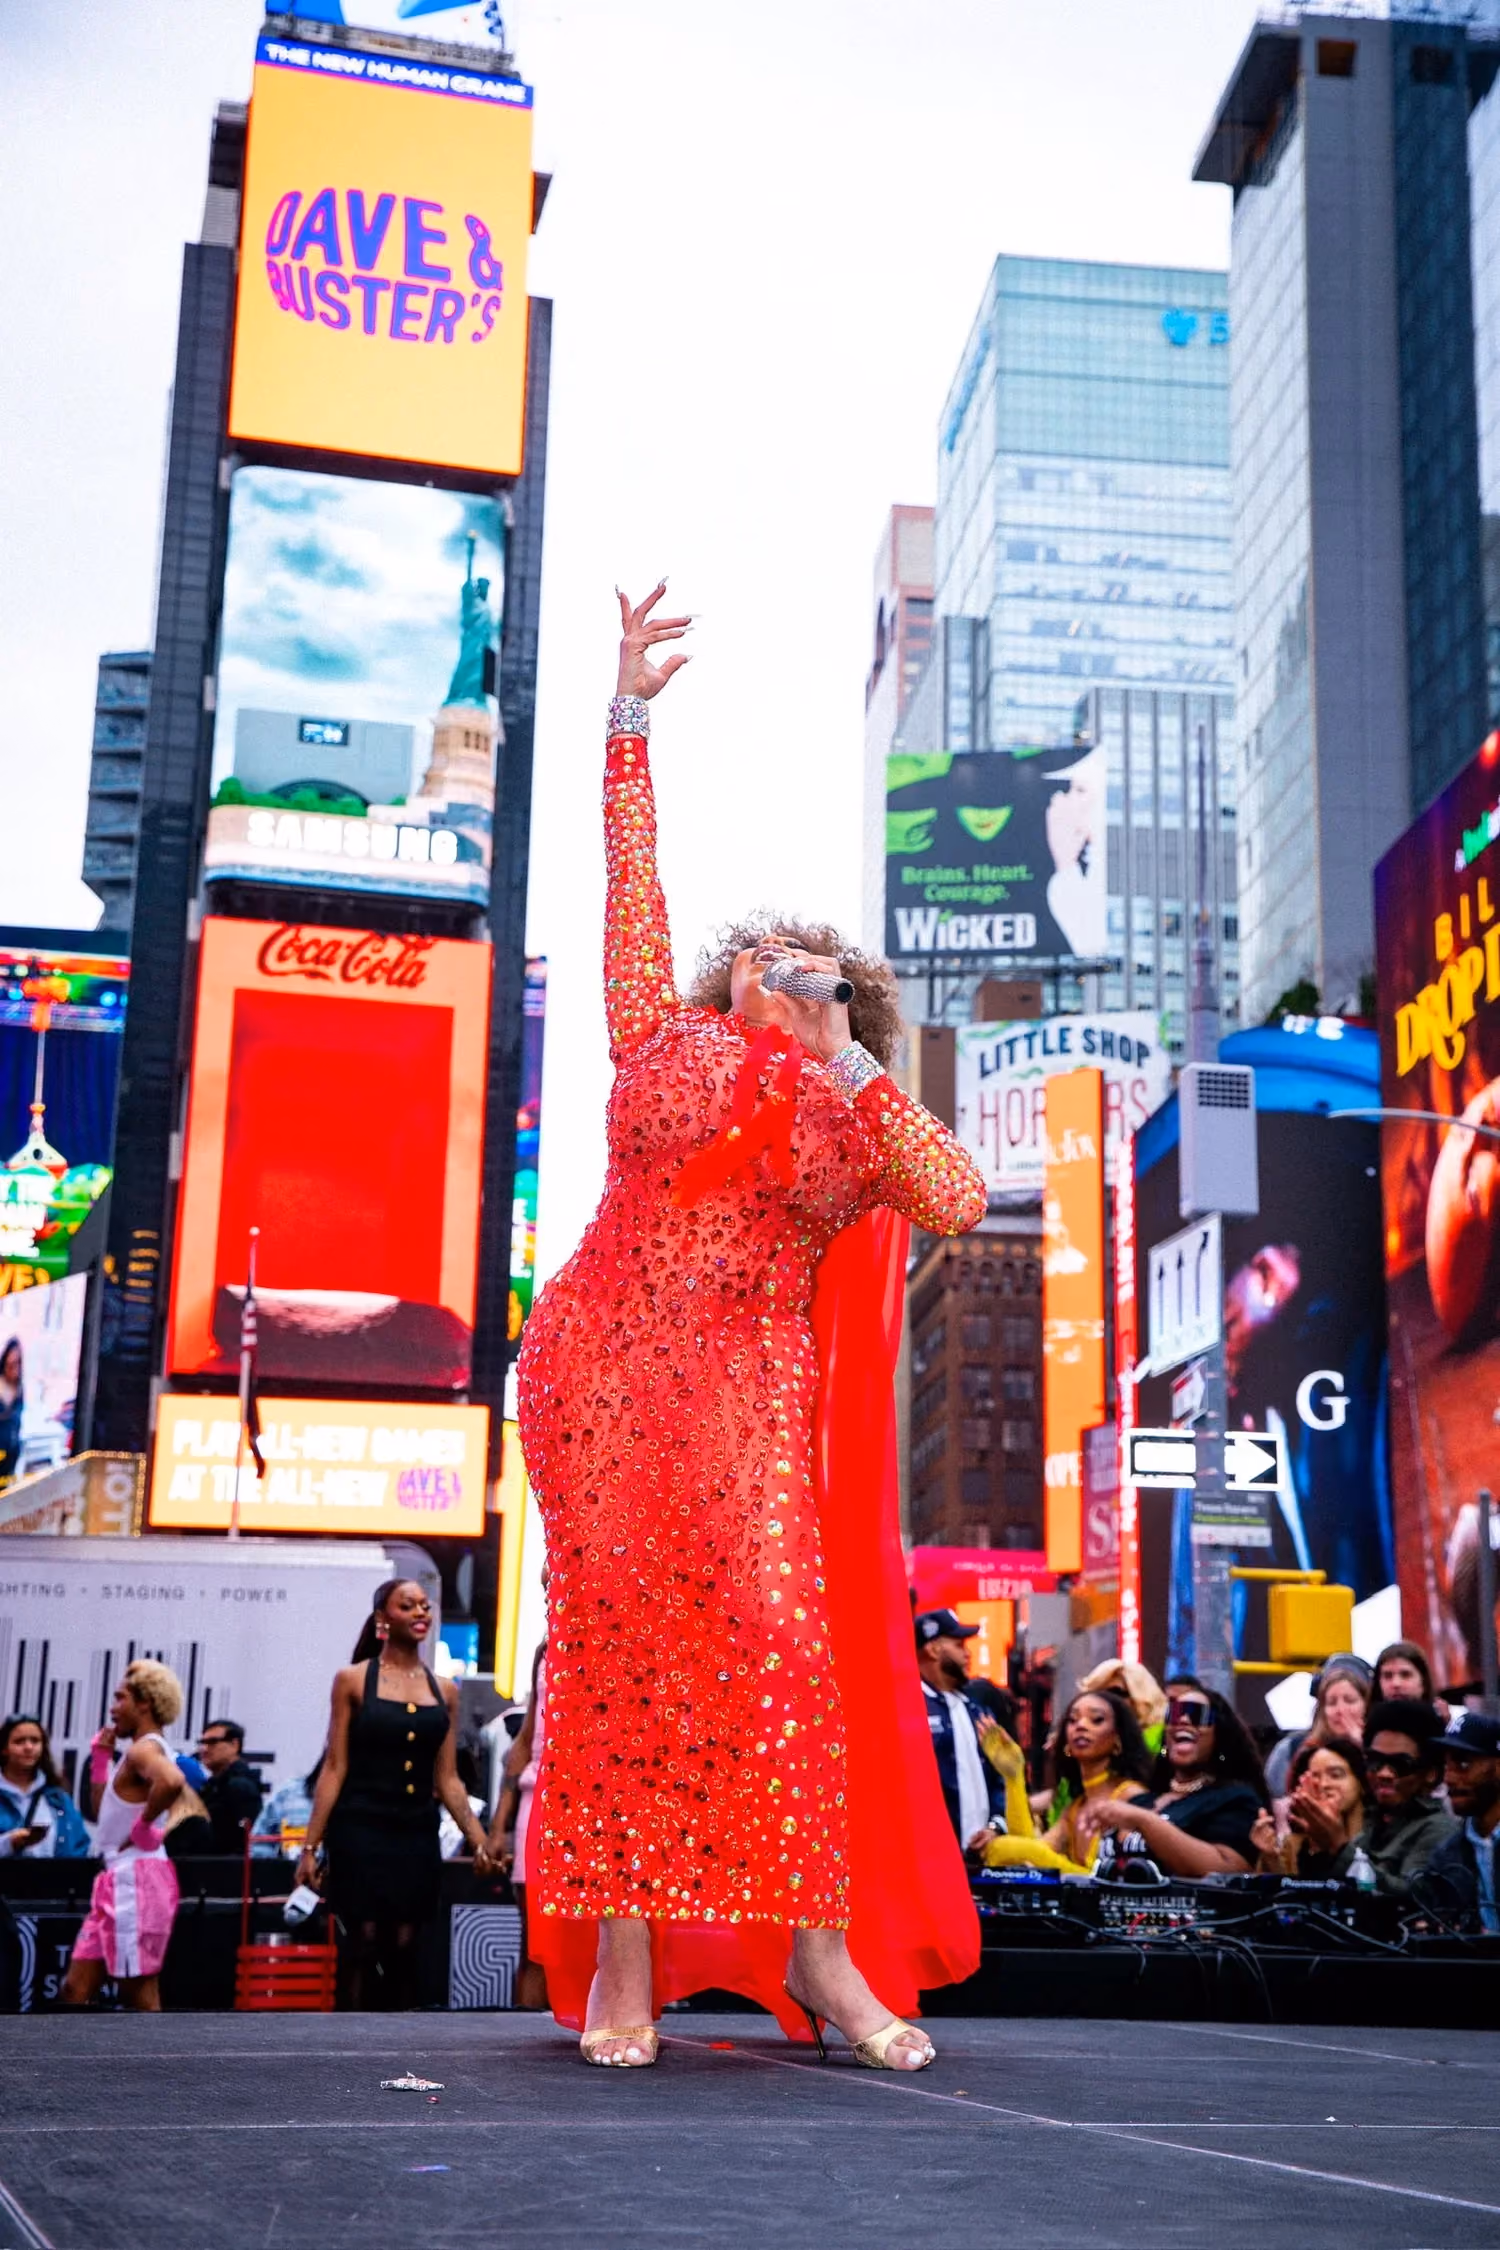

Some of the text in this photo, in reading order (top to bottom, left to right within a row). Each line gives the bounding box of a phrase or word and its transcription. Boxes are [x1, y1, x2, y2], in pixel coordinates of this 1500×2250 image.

[265, 43, 310, 66] THE
[313, 52, 366, 75] NEW
[367, 61, 449, 90] HUMAN
[265, 187, 451, 282] DAVE
[257, 922, 430, 988] Coca-Cola
[980, 1028, 1150, 1079] LITTLE SHOP
[1296, 1370, 1351, 1431] G
[101, 1583, 185, 1600] STAGING
[221, 1586, 287, 1602] POWER
[981, 1868, 1026, 1879] Pioneer
